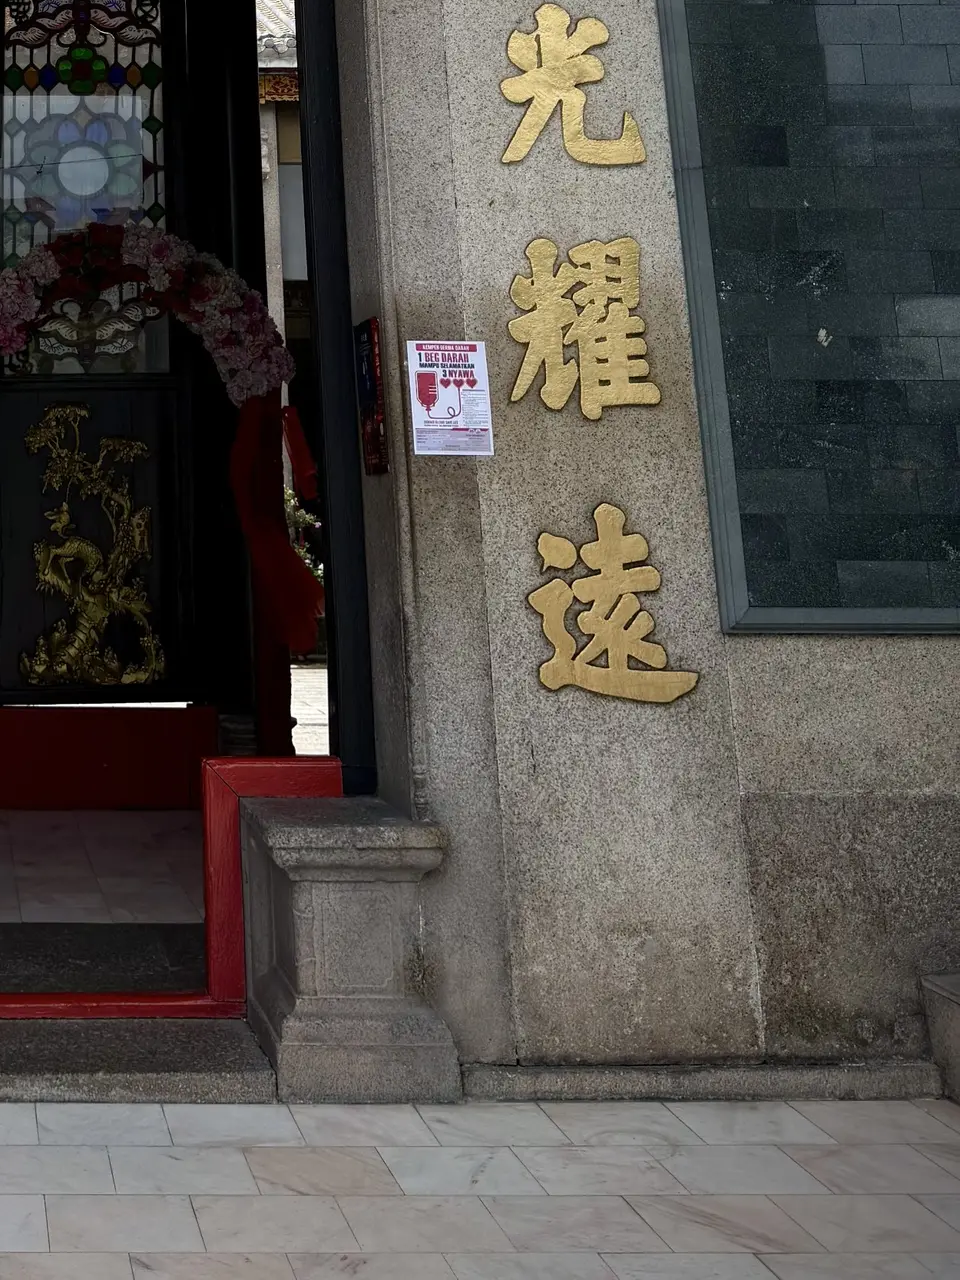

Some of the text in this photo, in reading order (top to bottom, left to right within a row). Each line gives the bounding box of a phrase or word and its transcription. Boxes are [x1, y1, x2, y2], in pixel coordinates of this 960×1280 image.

[418, 352, 470, 363] 1 BEG DARAH
[442, 370, 475, 378] 3 NYAWA
